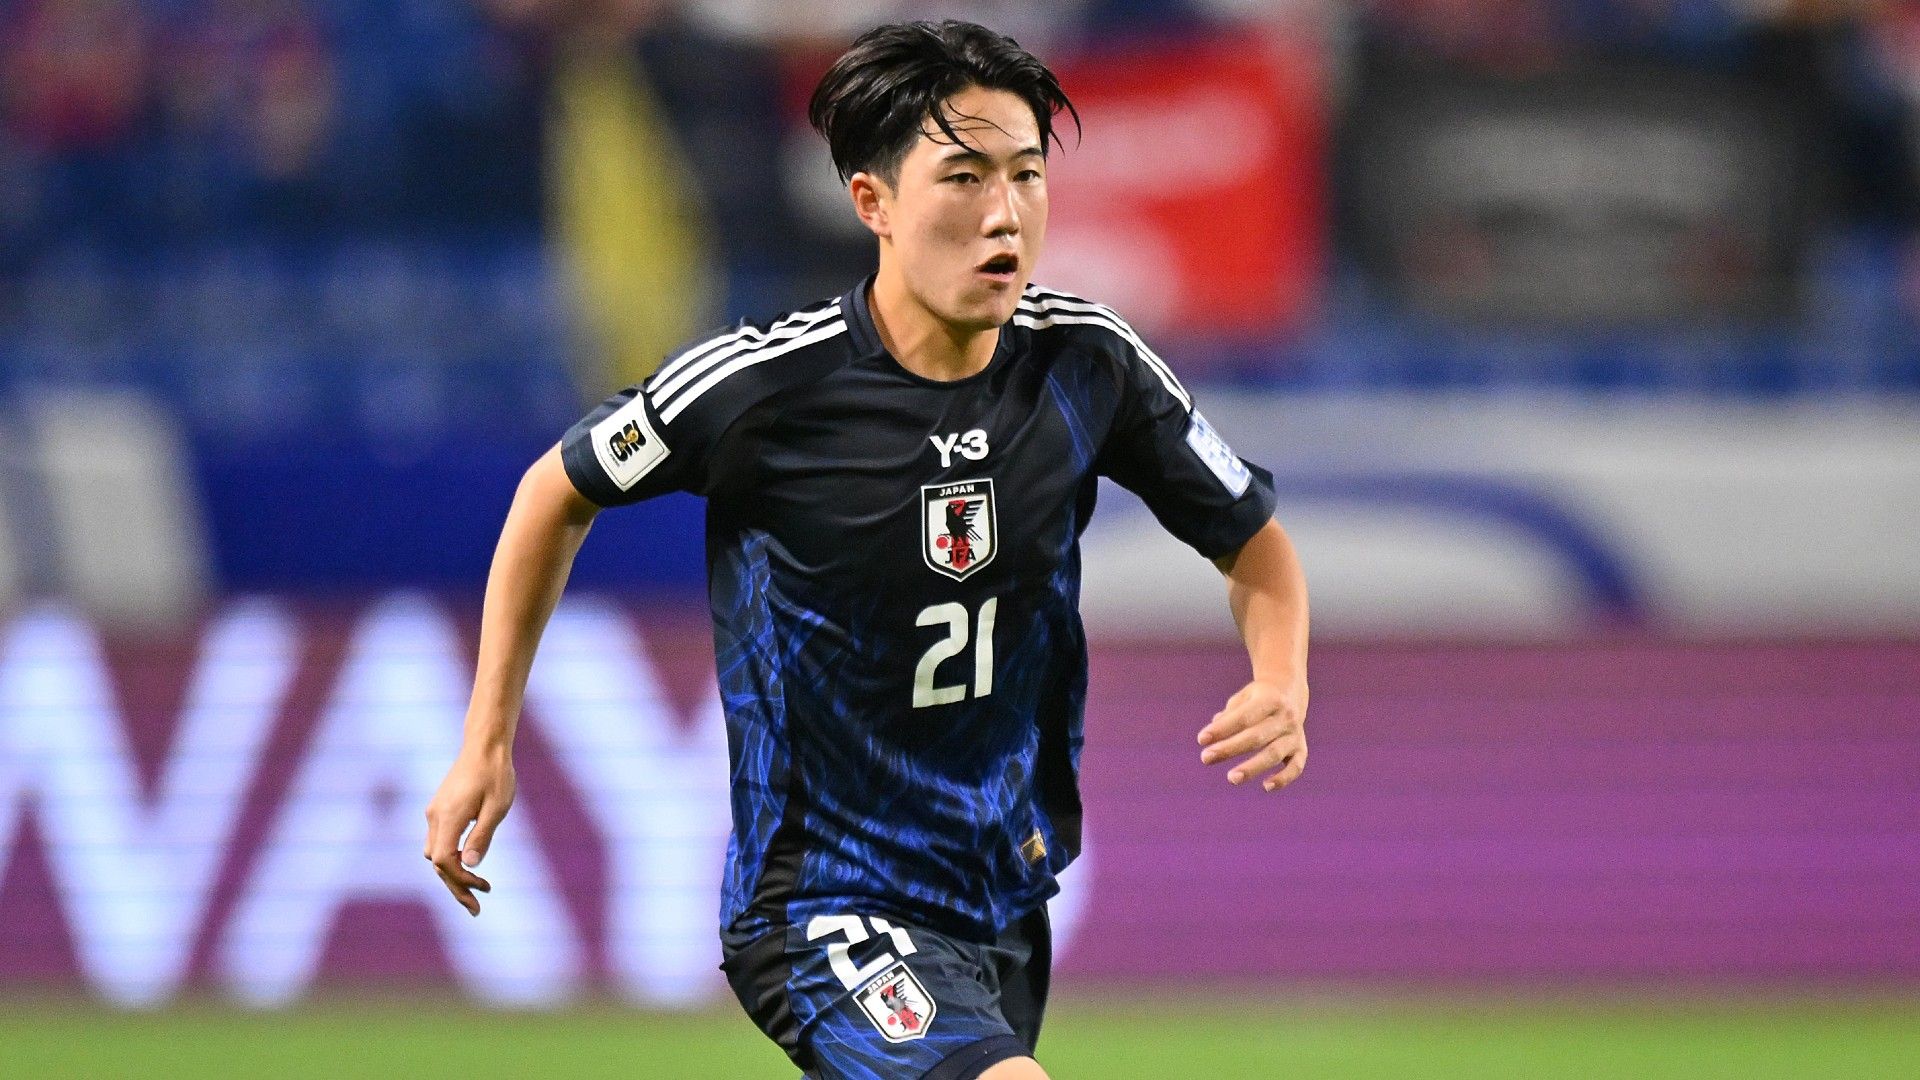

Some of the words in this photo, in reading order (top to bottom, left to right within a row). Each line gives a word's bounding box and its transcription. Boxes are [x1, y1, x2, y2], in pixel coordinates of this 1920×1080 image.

[929, 428, 990, 468] Y-3
[939, 484, 976, 497] JAPAN
[944, 547, 977, 564] JFA
[912, 597, 998, 708] 21
[0, 595, 1092, 1008] WAY
[807, 914, 918, 992] 21
[867, 971, 896, 994] JAPAN
